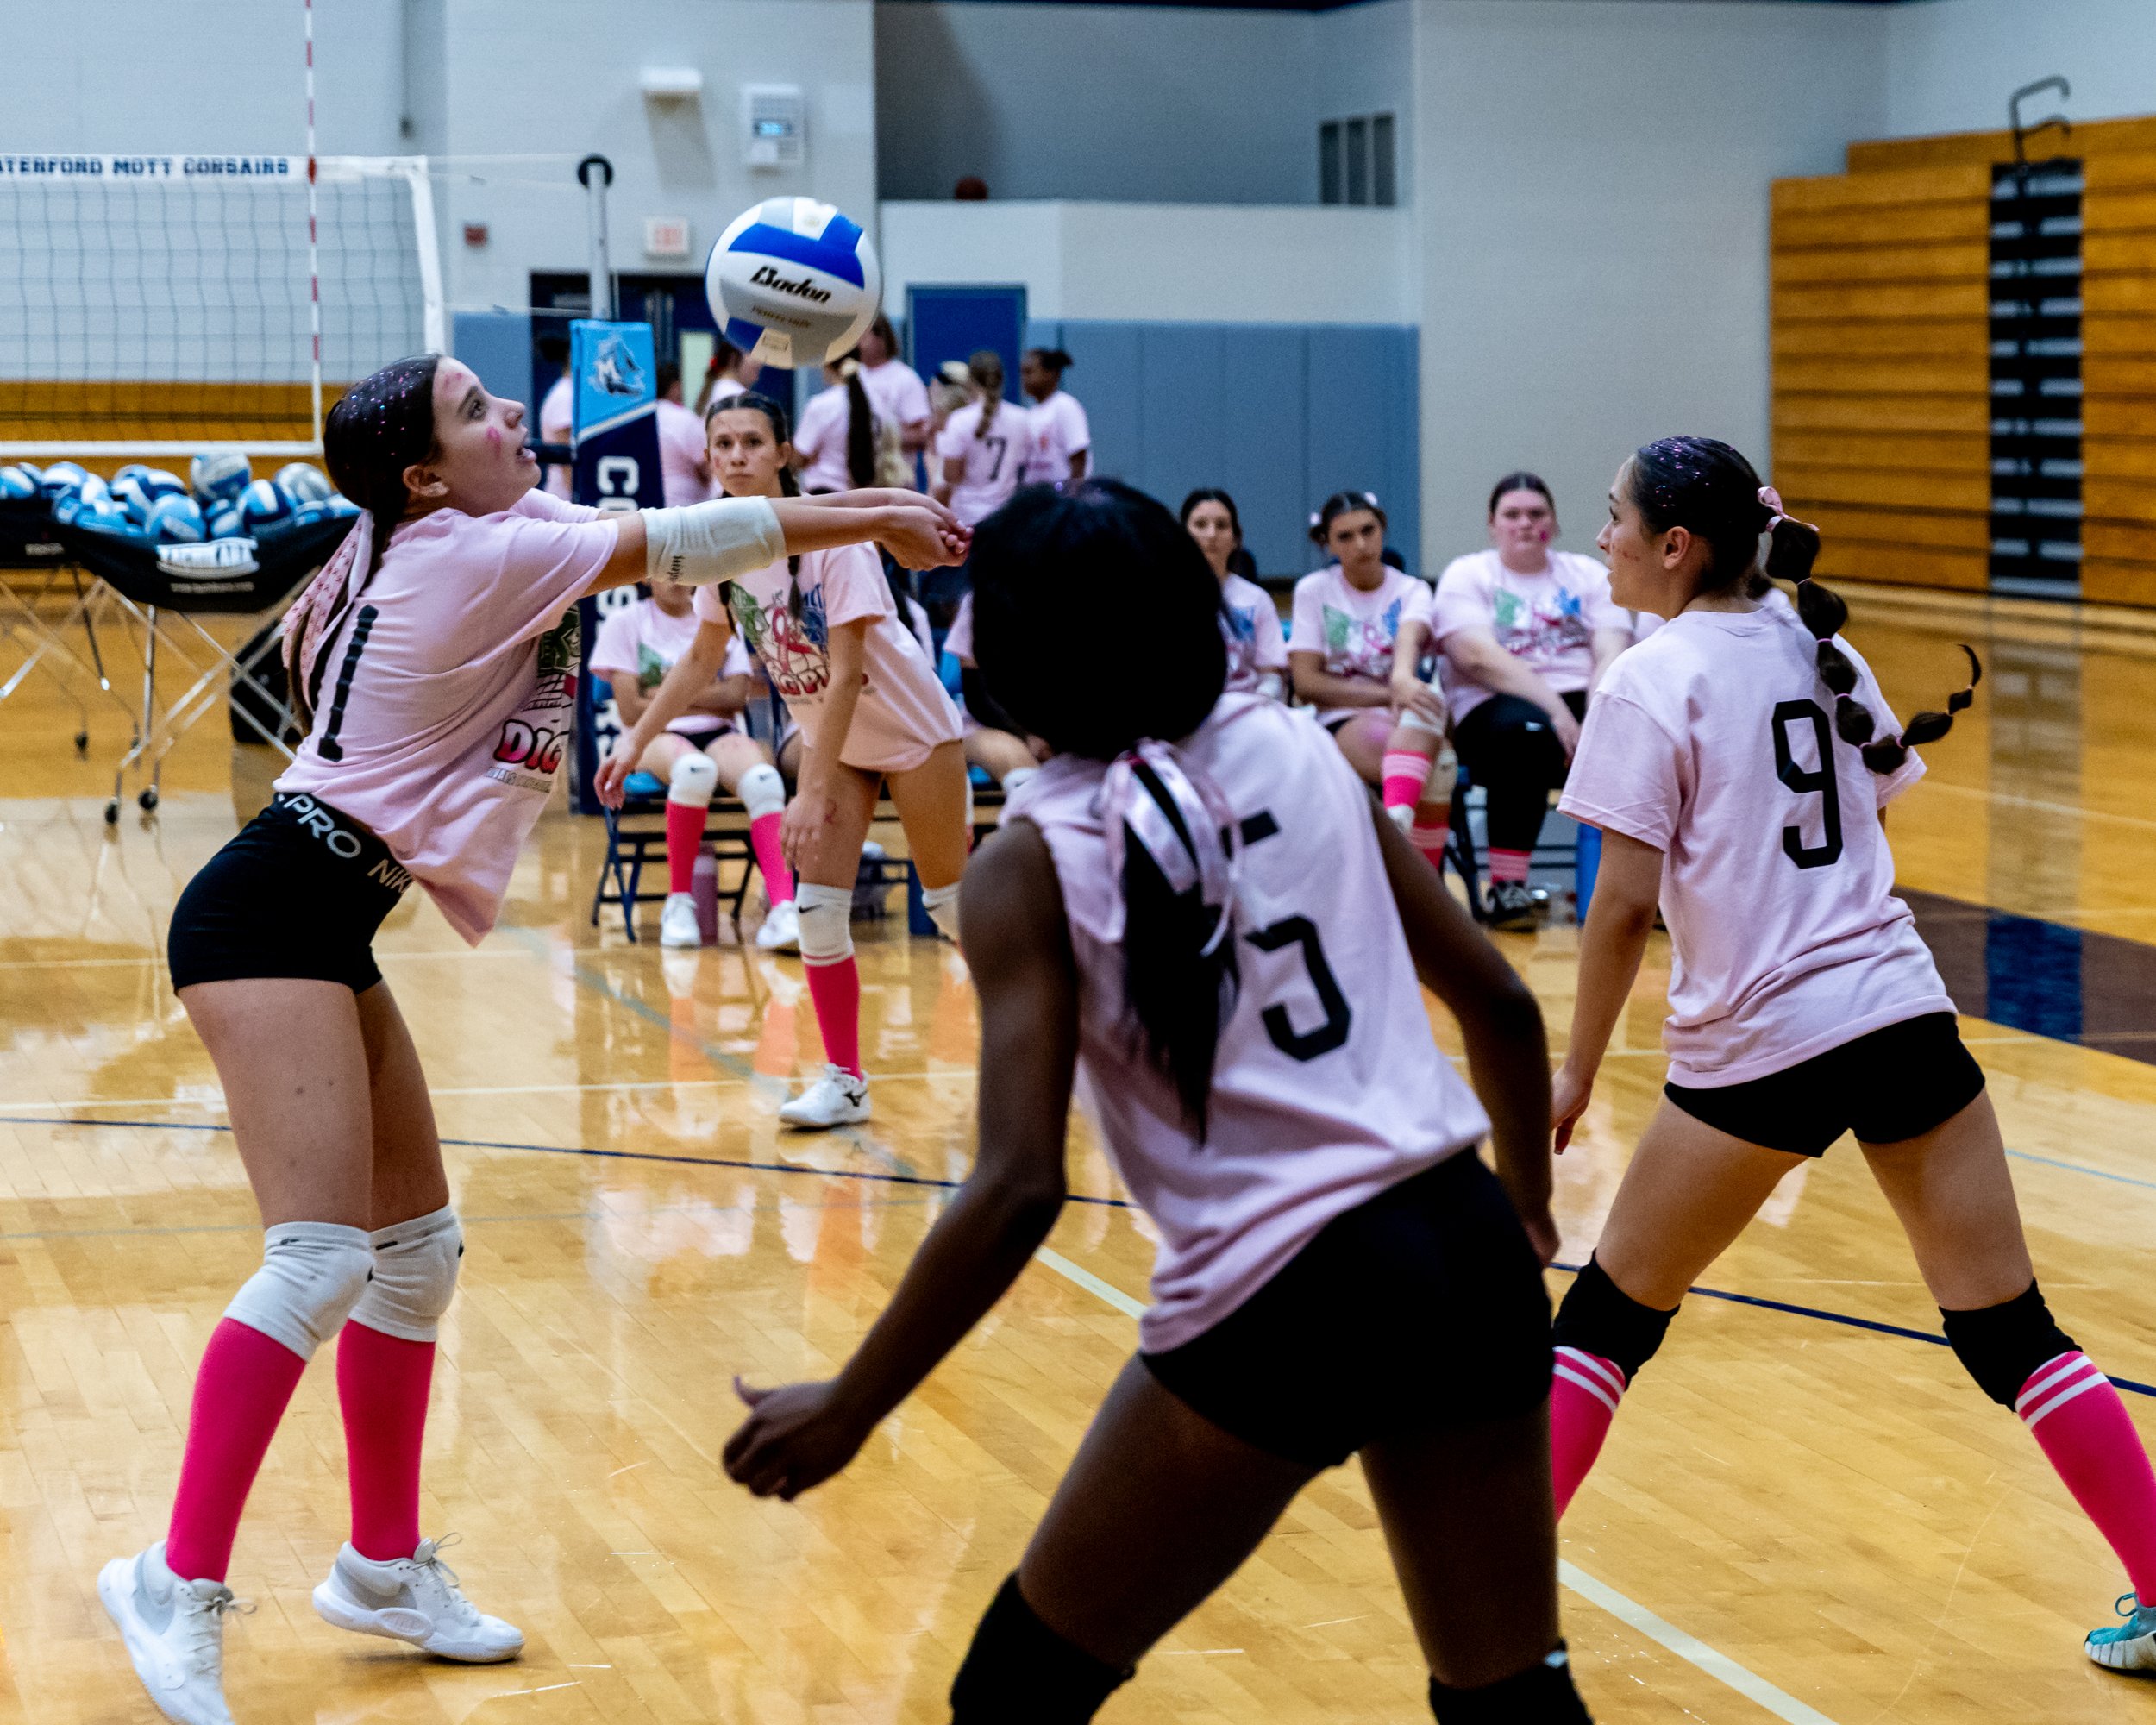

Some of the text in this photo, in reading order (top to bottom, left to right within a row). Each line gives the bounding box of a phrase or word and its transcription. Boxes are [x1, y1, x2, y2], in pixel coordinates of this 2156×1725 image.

[0, 156, 289, 175] TERFORD MOTT CORSAIRS
[986, 436, 1007, 480] 7
[1771, 699, 1843, 869] 9
[282, 794, 361, 859] PRO
[367, 858, 416, 894] NIK
